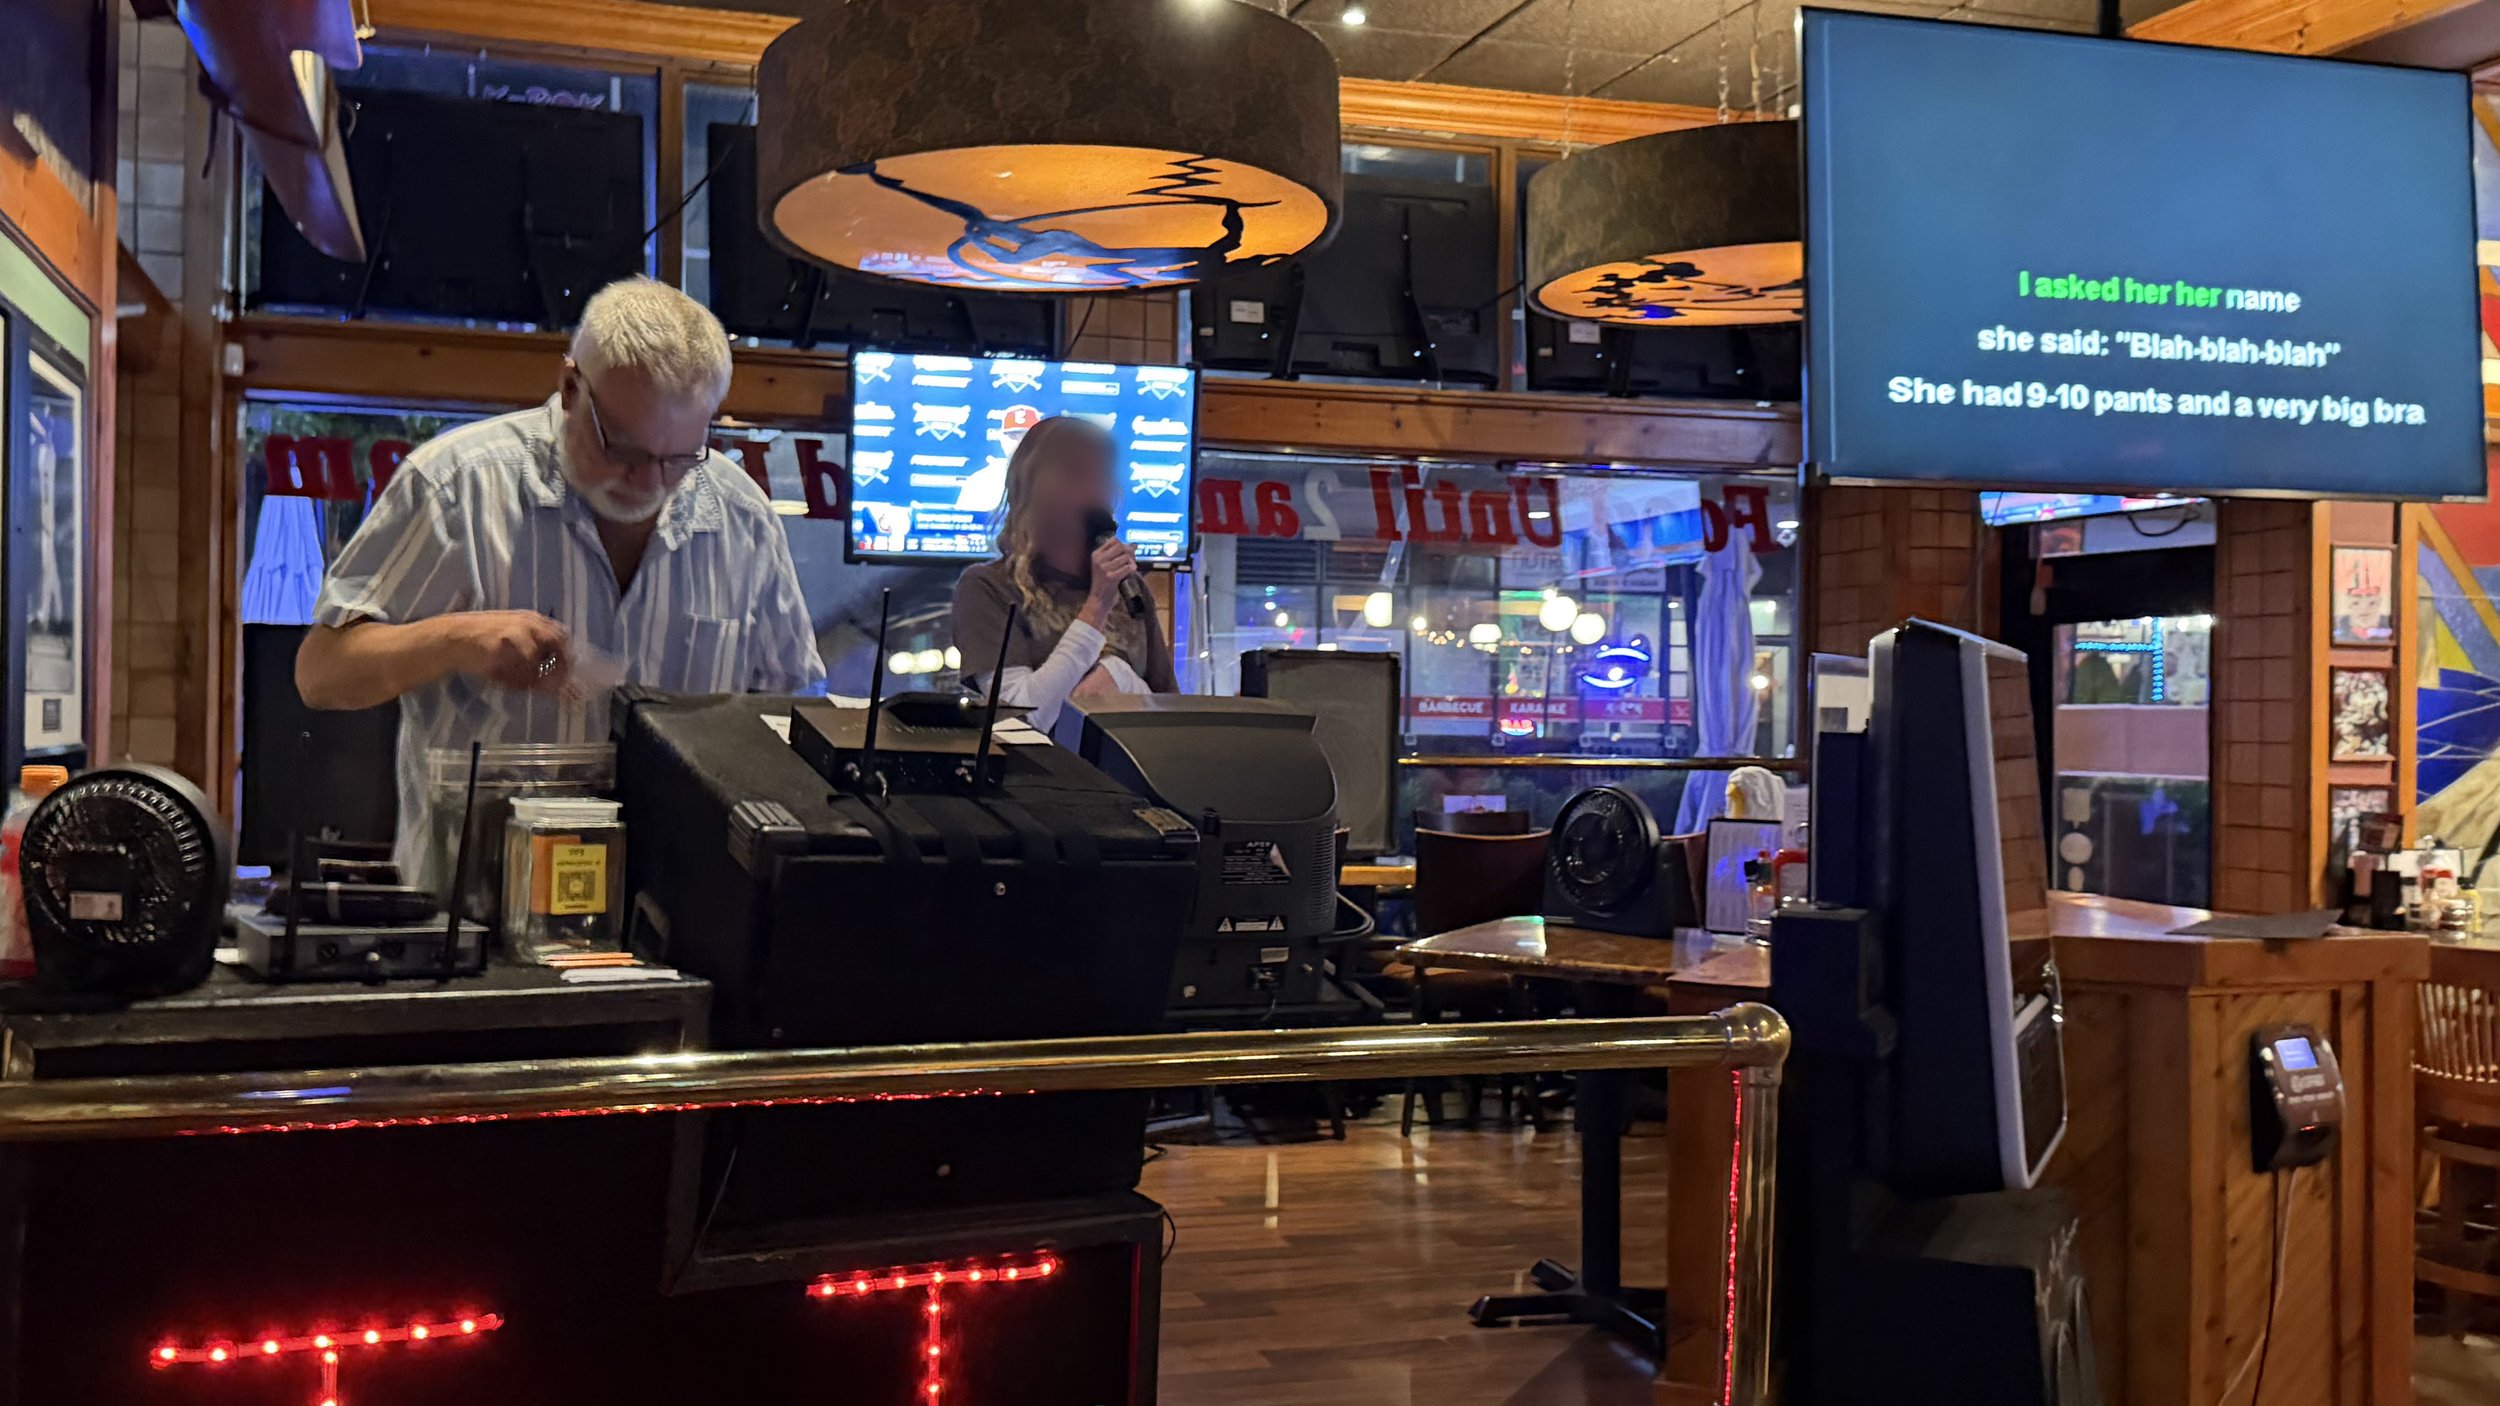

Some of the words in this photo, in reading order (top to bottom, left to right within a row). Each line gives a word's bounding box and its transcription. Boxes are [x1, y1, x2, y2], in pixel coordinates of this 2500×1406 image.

[2018, 270, 2031, 297] I
[2034, 273, 2121, 302] asked
[2124, 277, 2173, 305] her
[2175, 280, 2223, 308] her
[2225, 288, 2302, 314] name
[1977, 323, 2035, 352] she
[2040, 328, 2110, 357] said:
[1887, 375, 1956, 404] She
[1962, 379, 2023, 408] had
[2026, 381, 2090, 410] 9-10
[2094, 387, 2174, 417] pants
[2177, 390, 2231, 417] and
[2234, 396, 2254, 418] a
[2257, 397, 2320, 426] very
[2321, 394, 2370, 428] big
[2373, 397, 2427, 426] bra
[1418, 701, 1485, 714] BARBECUE
